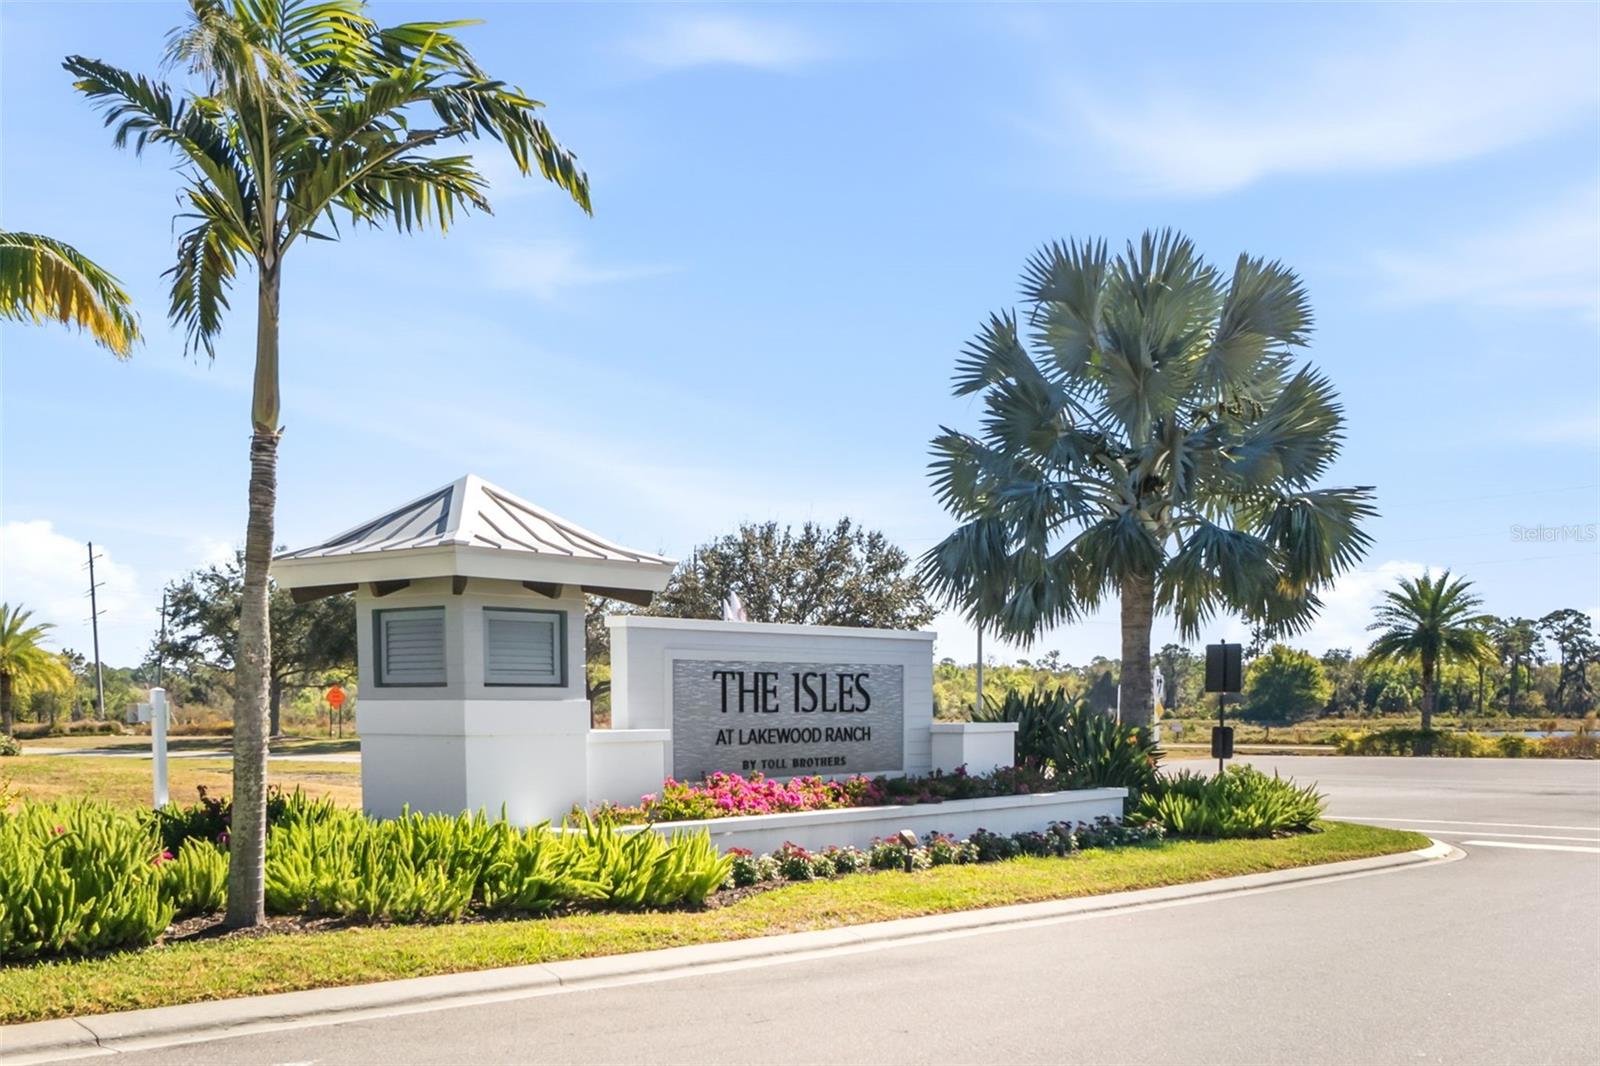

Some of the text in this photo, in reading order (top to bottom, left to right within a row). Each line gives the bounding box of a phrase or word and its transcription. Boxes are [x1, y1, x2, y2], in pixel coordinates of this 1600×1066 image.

[712, 670, 871, 713] THE ISLES
[715, 726, 871, 746] AT LAKEWOOD RANCH
[742, 756, 847, 770] BY TOLL BROTHERS
